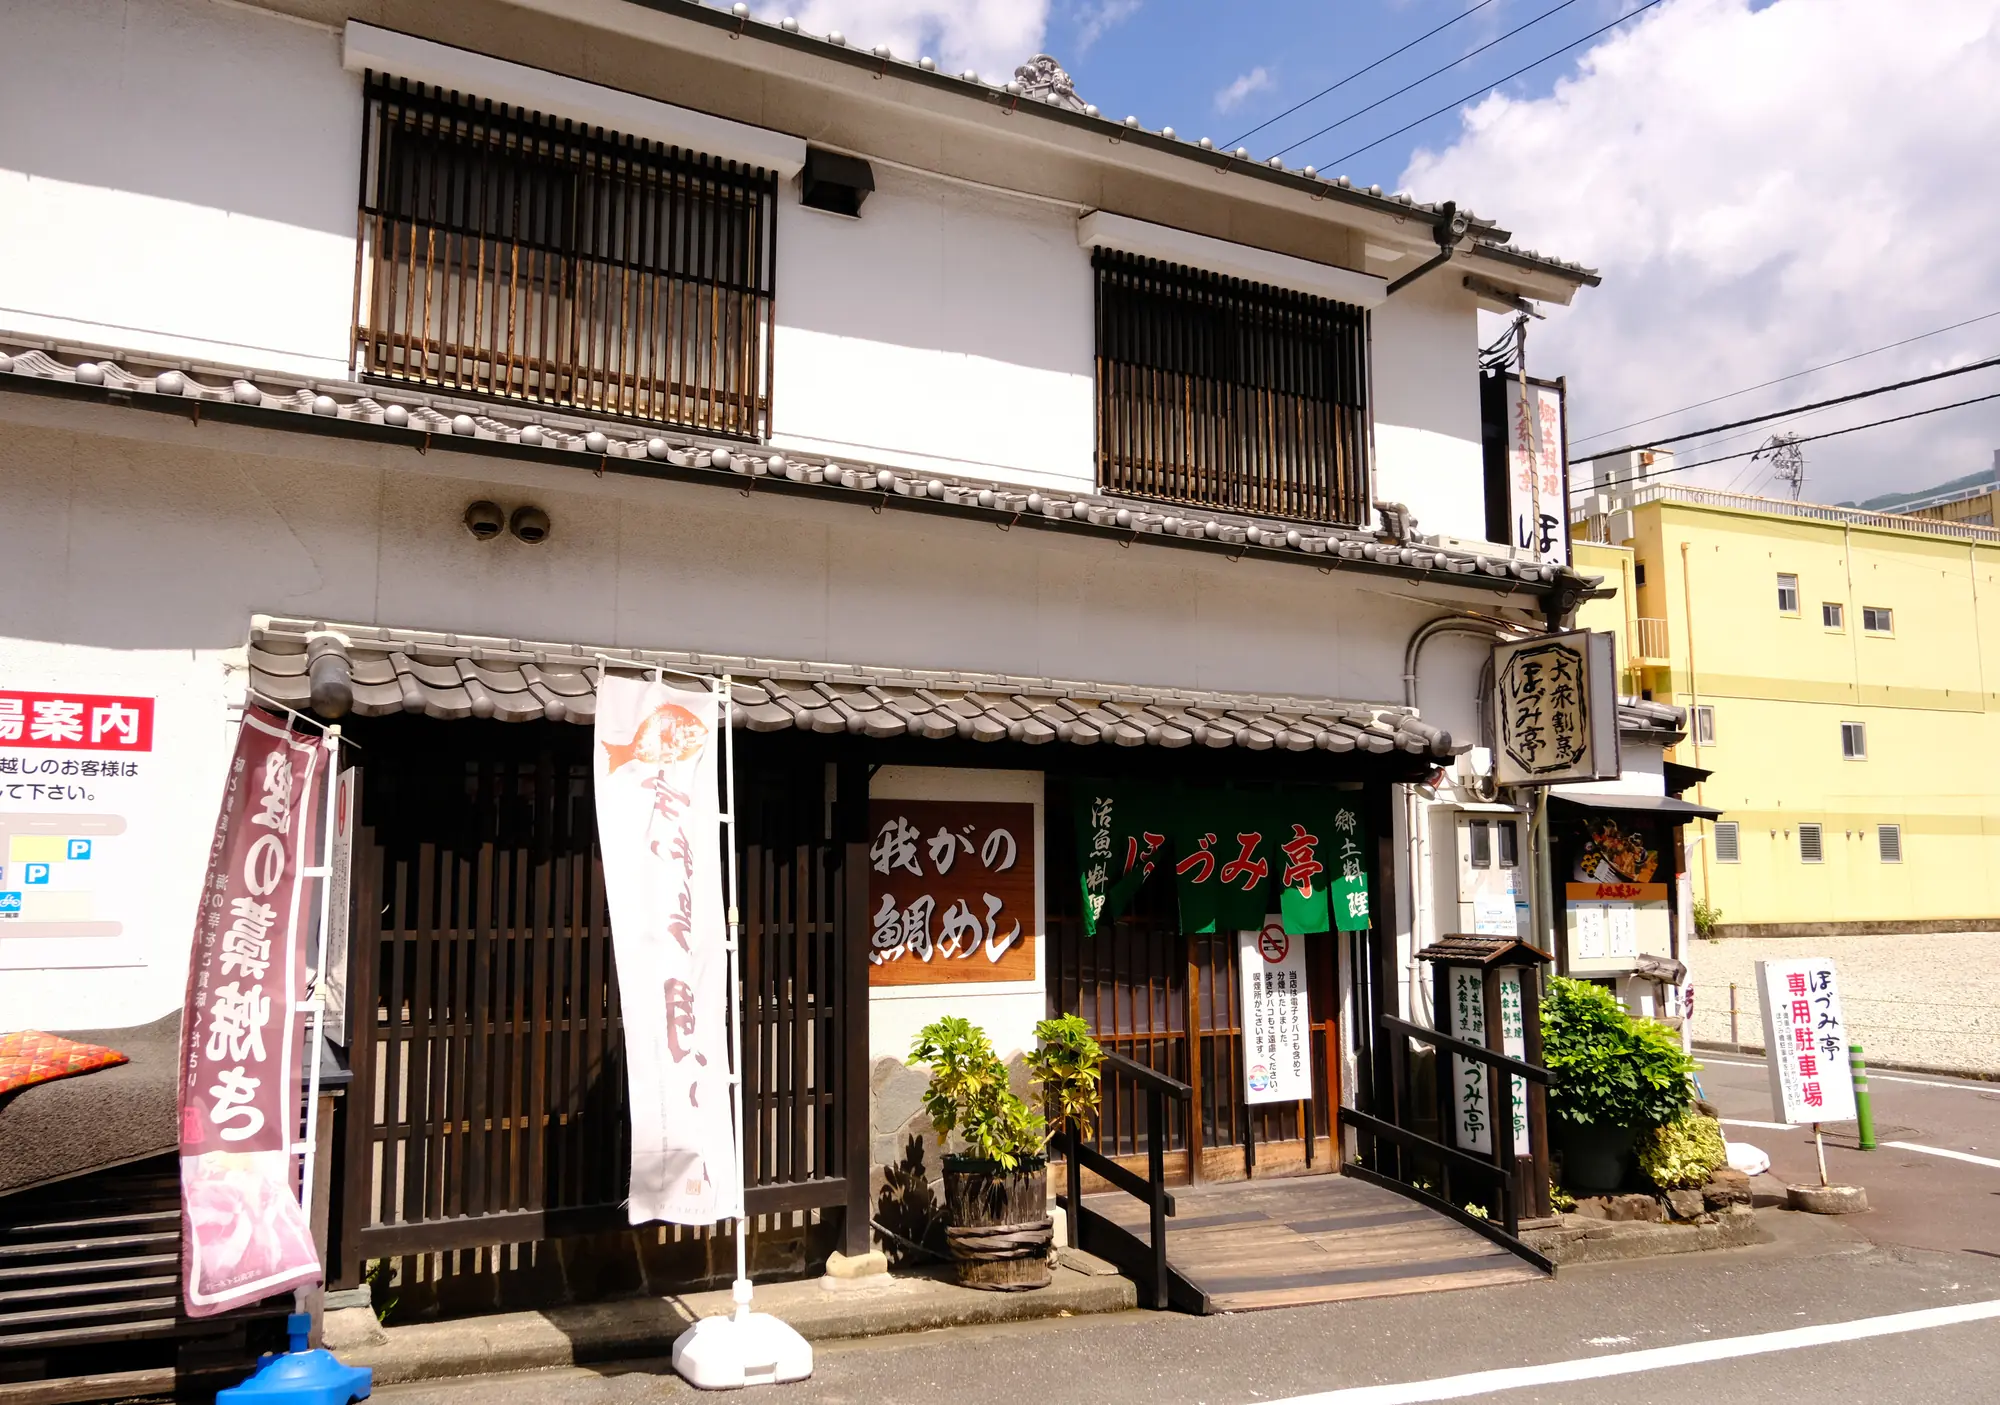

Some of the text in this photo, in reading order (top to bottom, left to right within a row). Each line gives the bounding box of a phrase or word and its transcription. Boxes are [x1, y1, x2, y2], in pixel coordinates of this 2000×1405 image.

[1538, 398, 1560, 497] 郷土料理
[1519, 513, 1560, 565] ほ
[1510, 661, 1547, 763] ほづみ亭
[1549, 658, 1576, 760] 大衆割烹
[0, 757, 139, 777] 越しのお客様は
[0, 784, 95, 801] て下さい。
[869, 815, 1017, 877] 我がの
[1087, 796, 1114, 922] 活魚料理
[1123, 823, 1325, 900] ほづみ亭
[1334, 807, 1370, 919] 郷土料理
[869, 891, 1021, 966] 鯛めし
[1265, 972, 1279, 1093] 歩きタバコもご遠慮ください。
[1276, 971, 1289, 1048] 分煙いたしました。
[1288, 970, 1301, 1078] 当店は電子タバコも含めて
[1469, 975, 1483, 1033] 郷土料理
[1509, 981, 1523, 1039] 郷土料理
[1786, 972, 1823, 1107] 専用駐車場
[1808, 970, 1840, 1062] ほづみ亭
